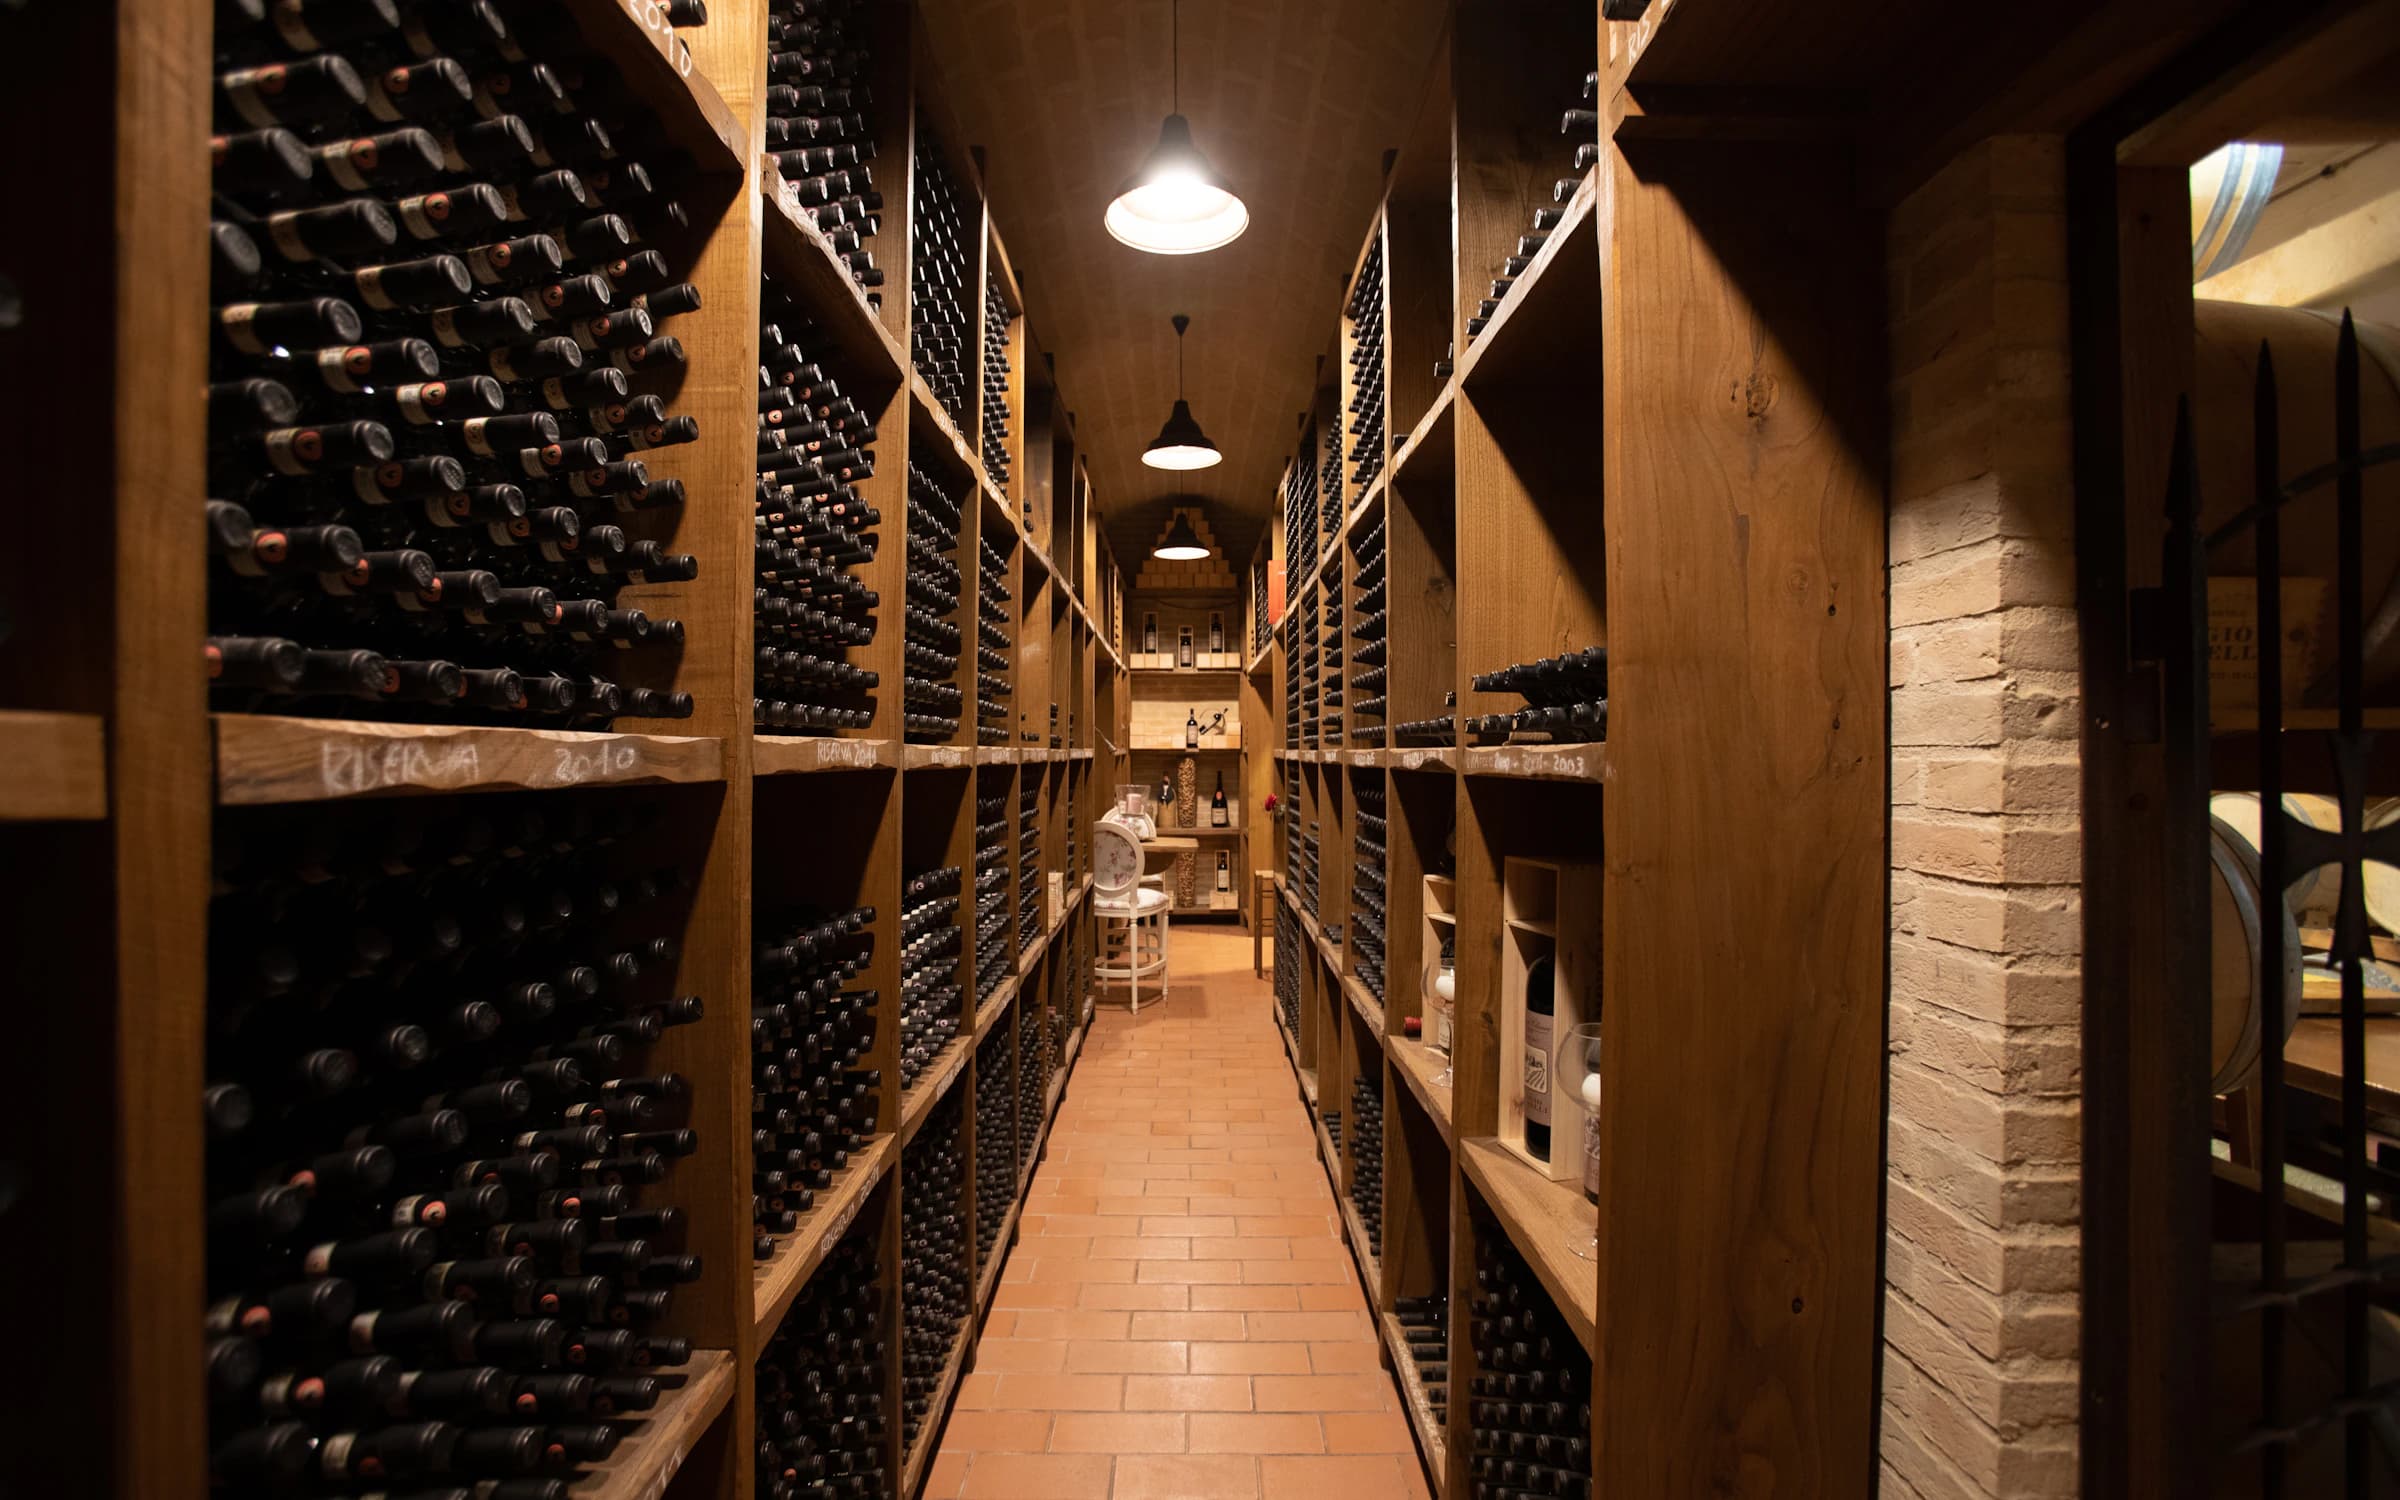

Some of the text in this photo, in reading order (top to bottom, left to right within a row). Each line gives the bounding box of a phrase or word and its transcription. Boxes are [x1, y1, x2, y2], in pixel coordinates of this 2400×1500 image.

[321, 740, 637, 794] RISERVA 2010
[817, 742, 852, 765] RISERVA
